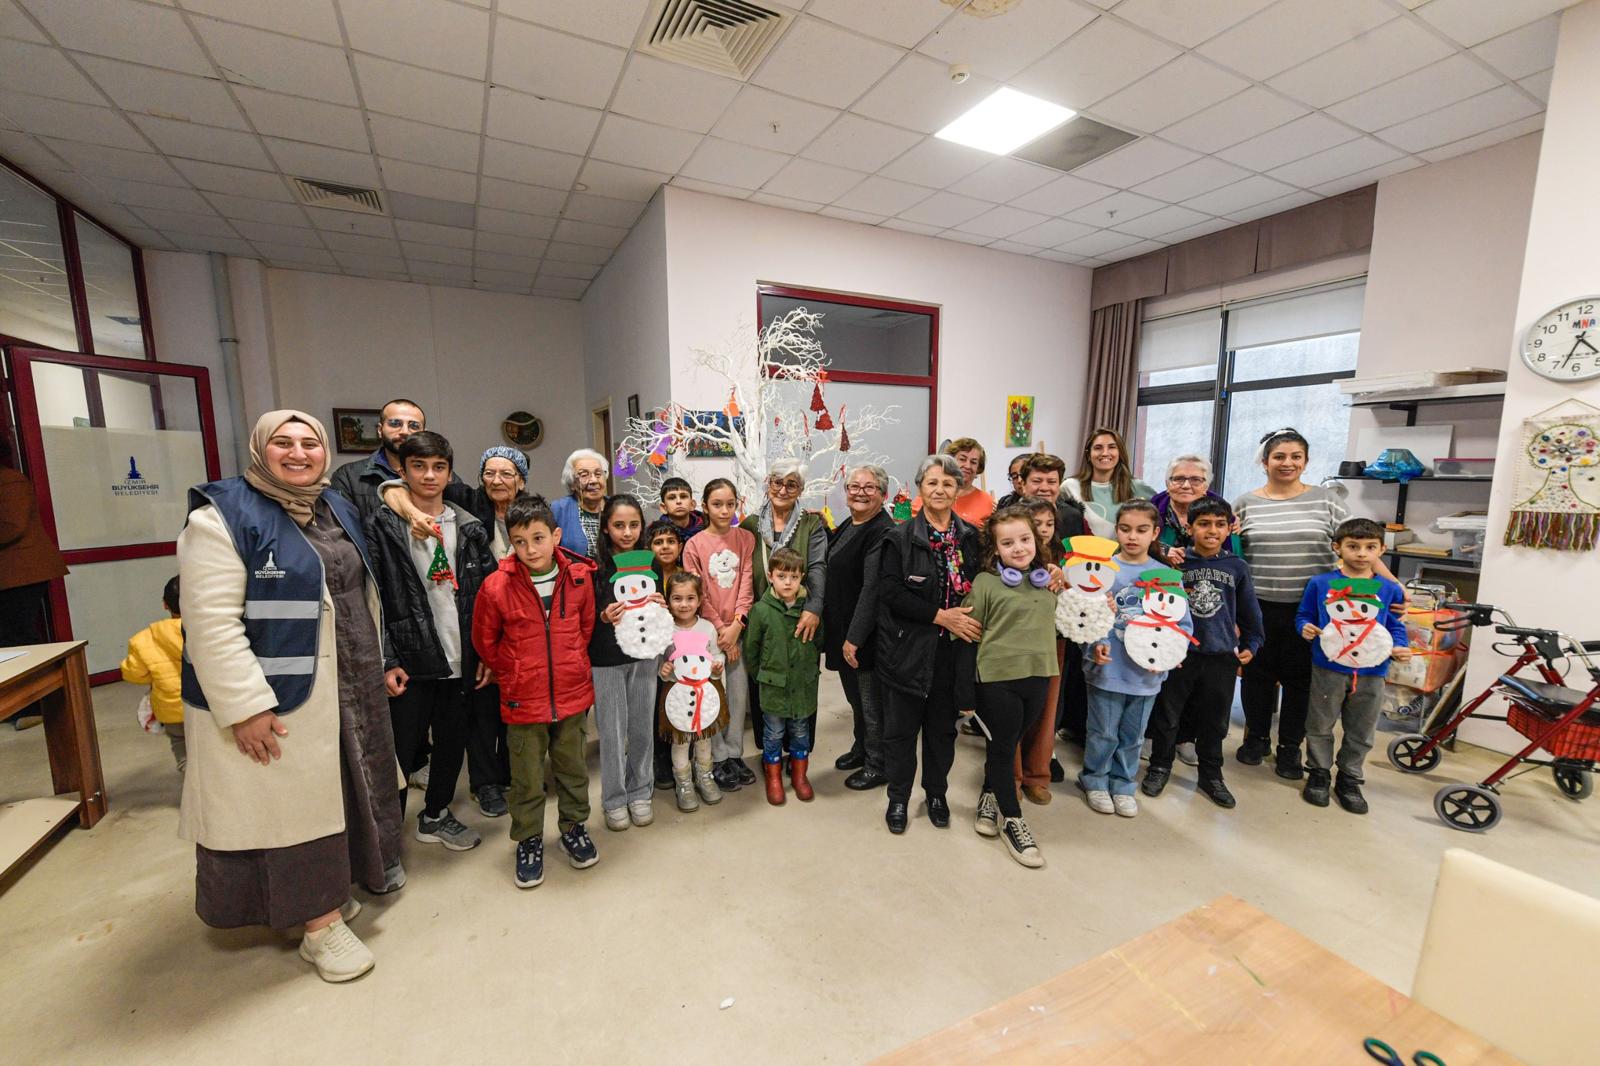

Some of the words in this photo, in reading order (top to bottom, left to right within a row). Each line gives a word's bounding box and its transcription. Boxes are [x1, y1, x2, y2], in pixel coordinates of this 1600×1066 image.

[1577, 304, 1594, 315] 12
[1557, 312, 1569, 322] 11
[1542, 324, 1557, 334] 10
[1533, 339, 1543, 349] 9
[1537, 353, 1546, 362] 8
[1552, 360, 1560, 370] 7
[1571, 363, 1581, 373] 6
